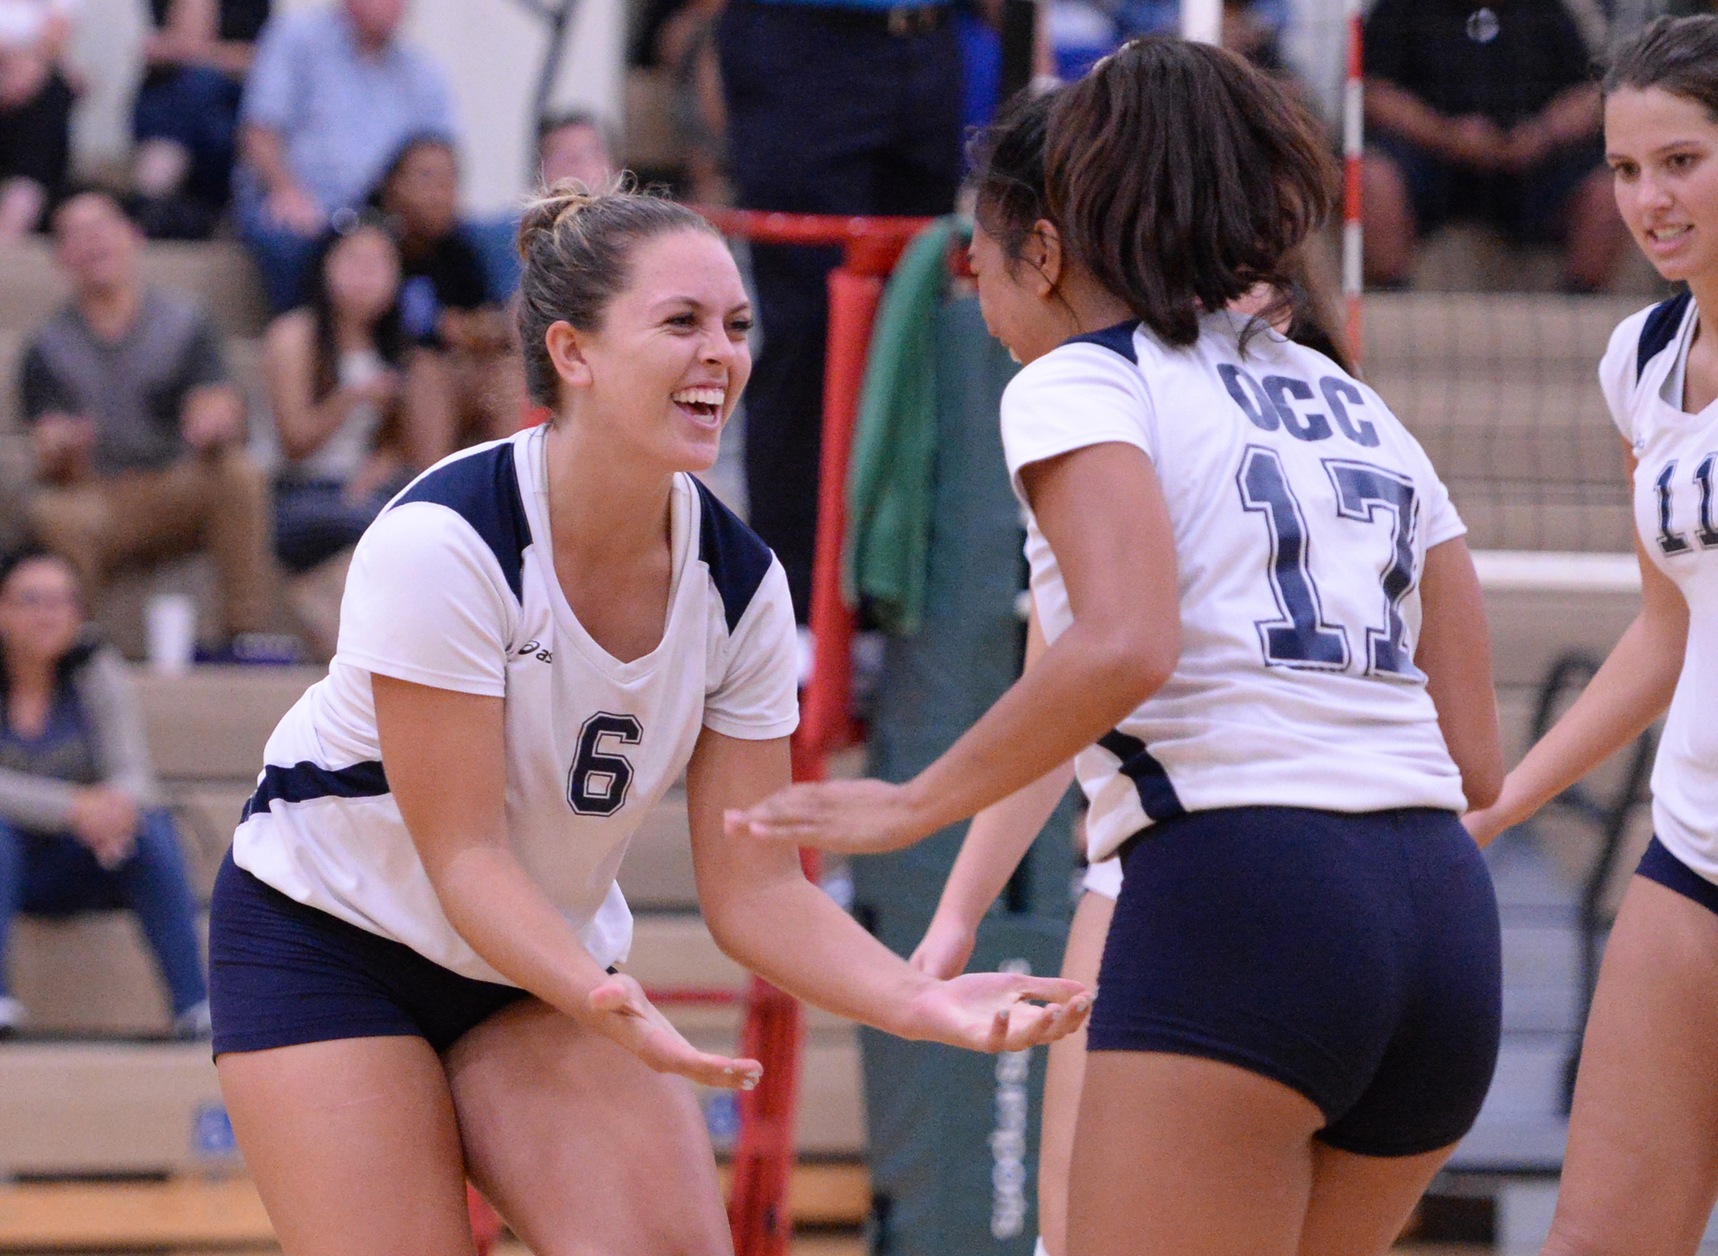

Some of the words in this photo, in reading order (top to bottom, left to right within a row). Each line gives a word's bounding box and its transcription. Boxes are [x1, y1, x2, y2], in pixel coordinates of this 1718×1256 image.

[1217, 363, 1380, 448] OCC
[1654, 451, 1718, 558] 11
[1236, 443, 1429, 677] 17
[567, 710, 644, 818] 6
